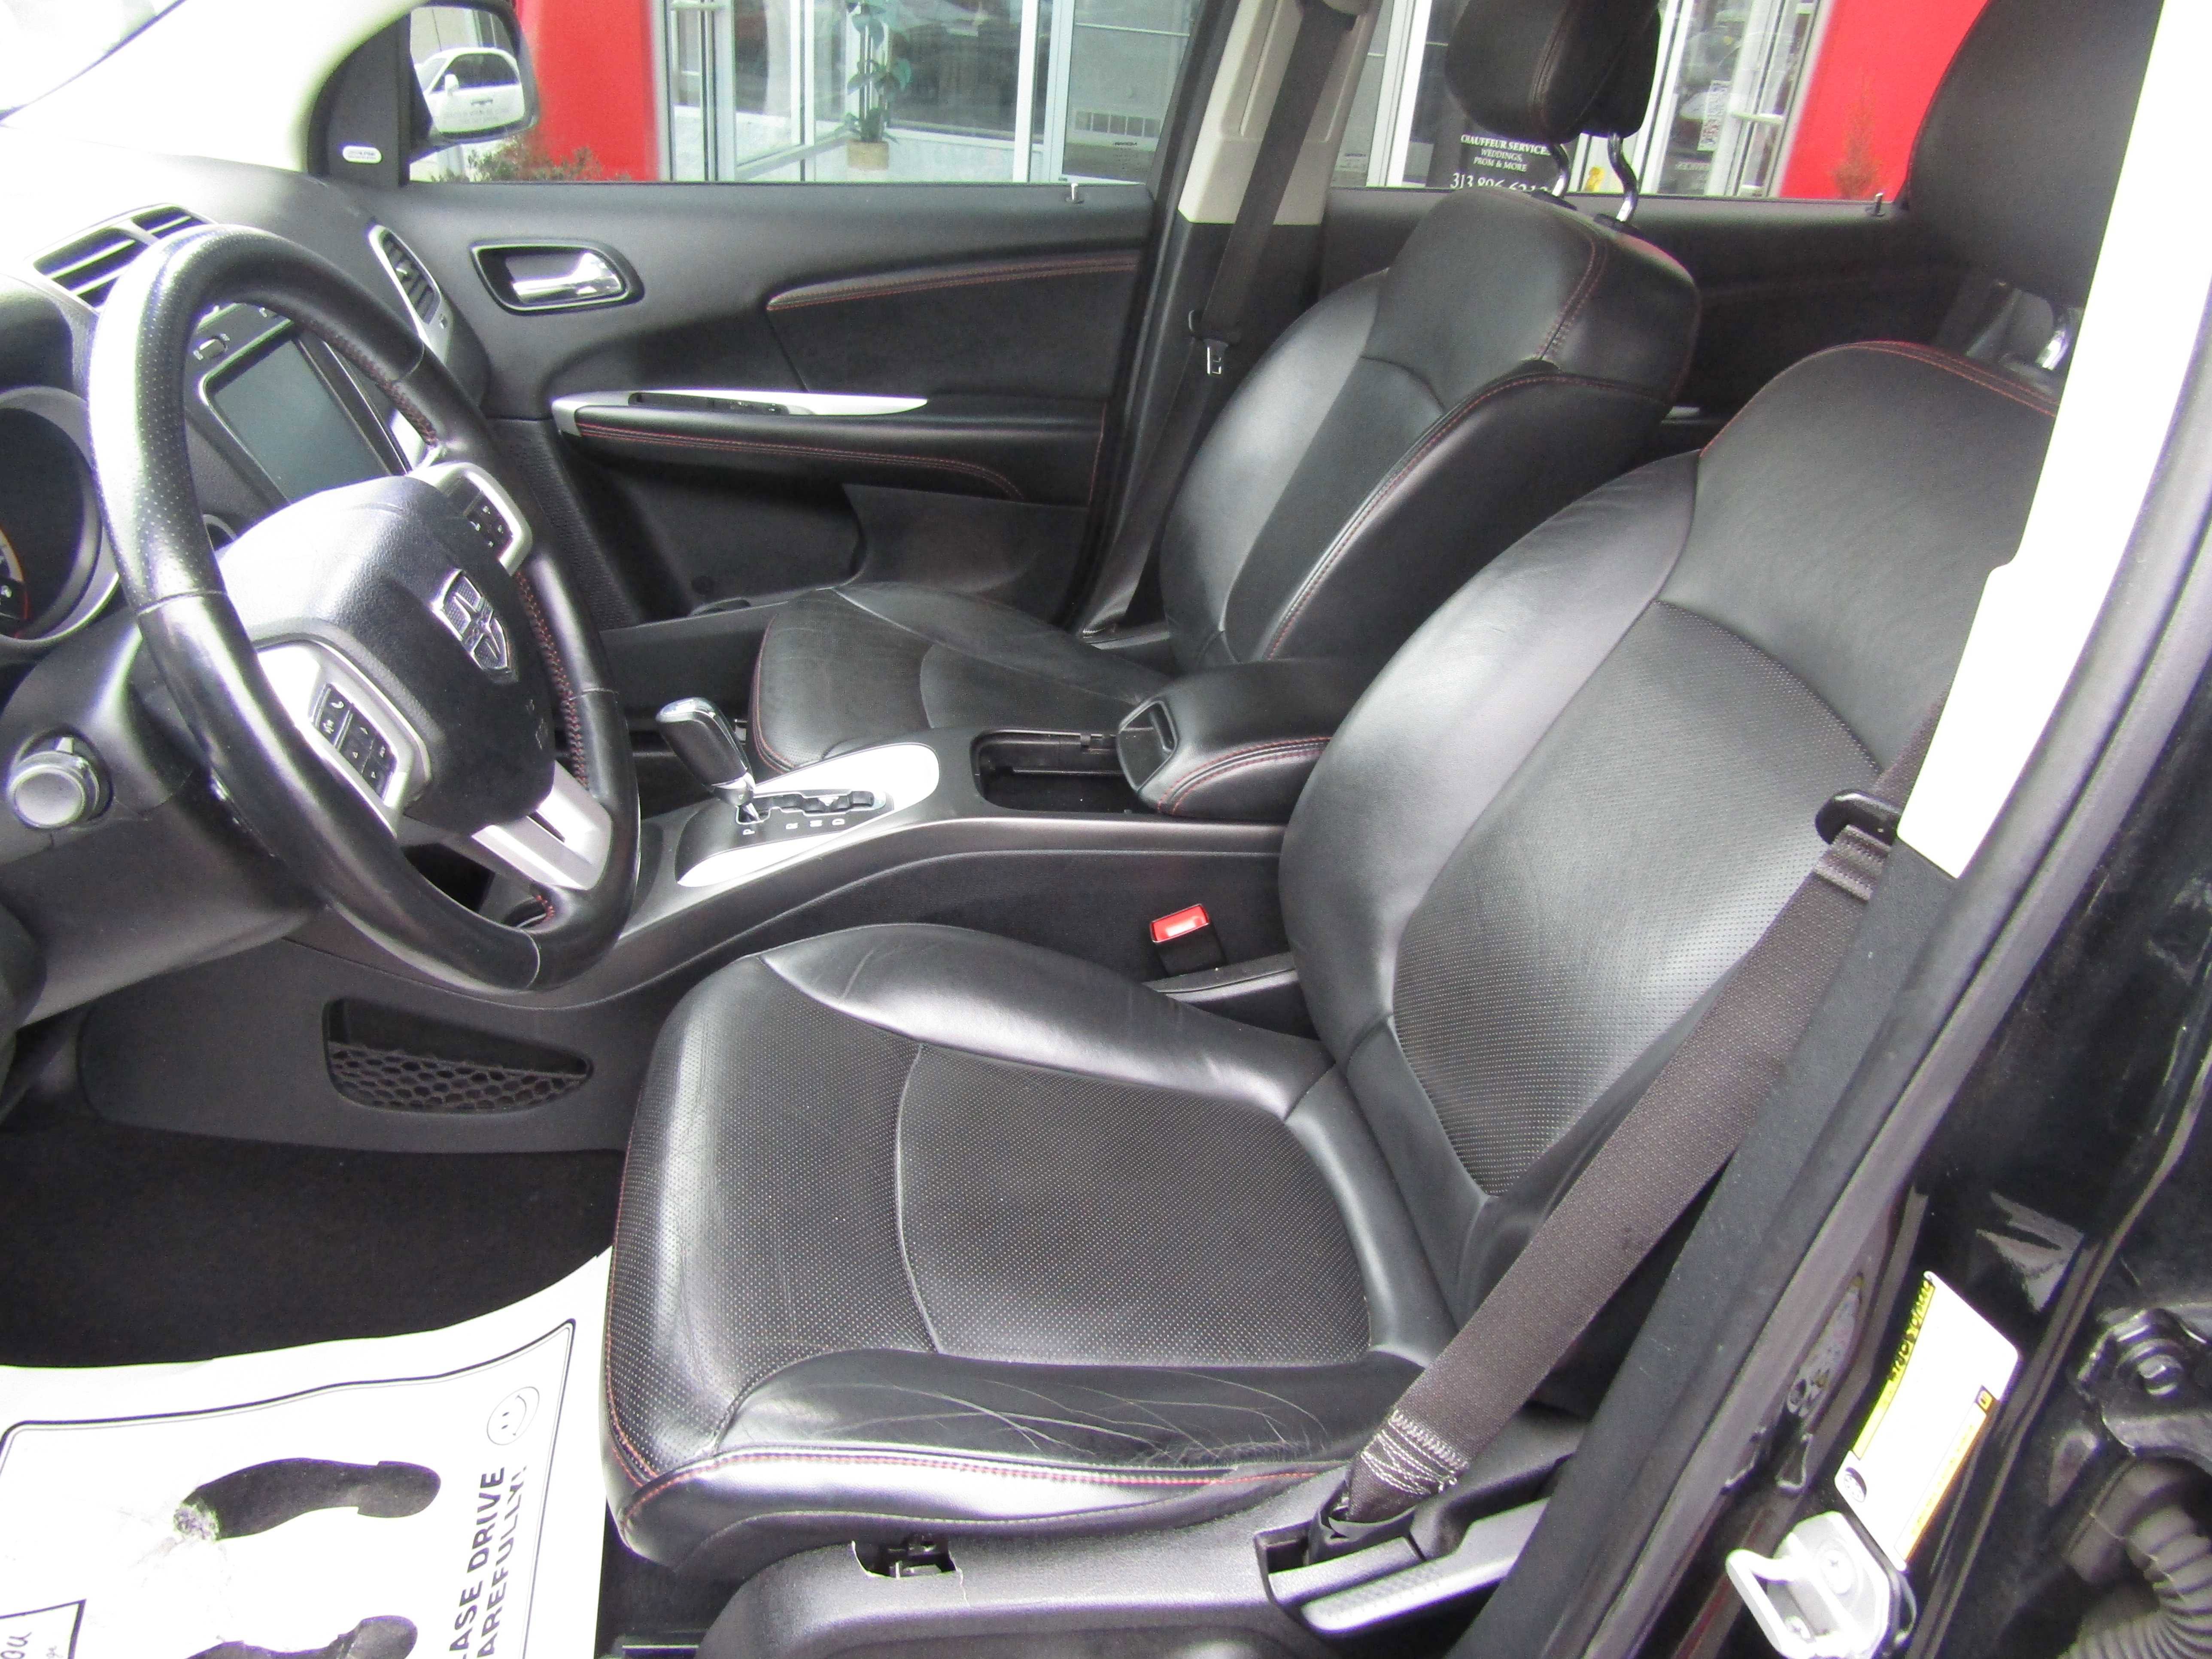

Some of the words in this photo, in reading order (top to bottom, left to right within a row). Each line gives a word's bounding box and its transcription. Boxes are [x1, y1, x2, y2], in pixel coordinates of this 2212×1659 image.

[1461, 134, 1507, 149] CHAUFFEUR
[1507, 141, 1550, 156] SERVICE
[1474, 157, 1495, 167] PROM
[1503, 162, 1527, 172] MORE
[1450, 173, 1474, 188] 313
[449, 1580, 483, 1659] ASE
[467, 1467, 504, 1573] DRIVE
